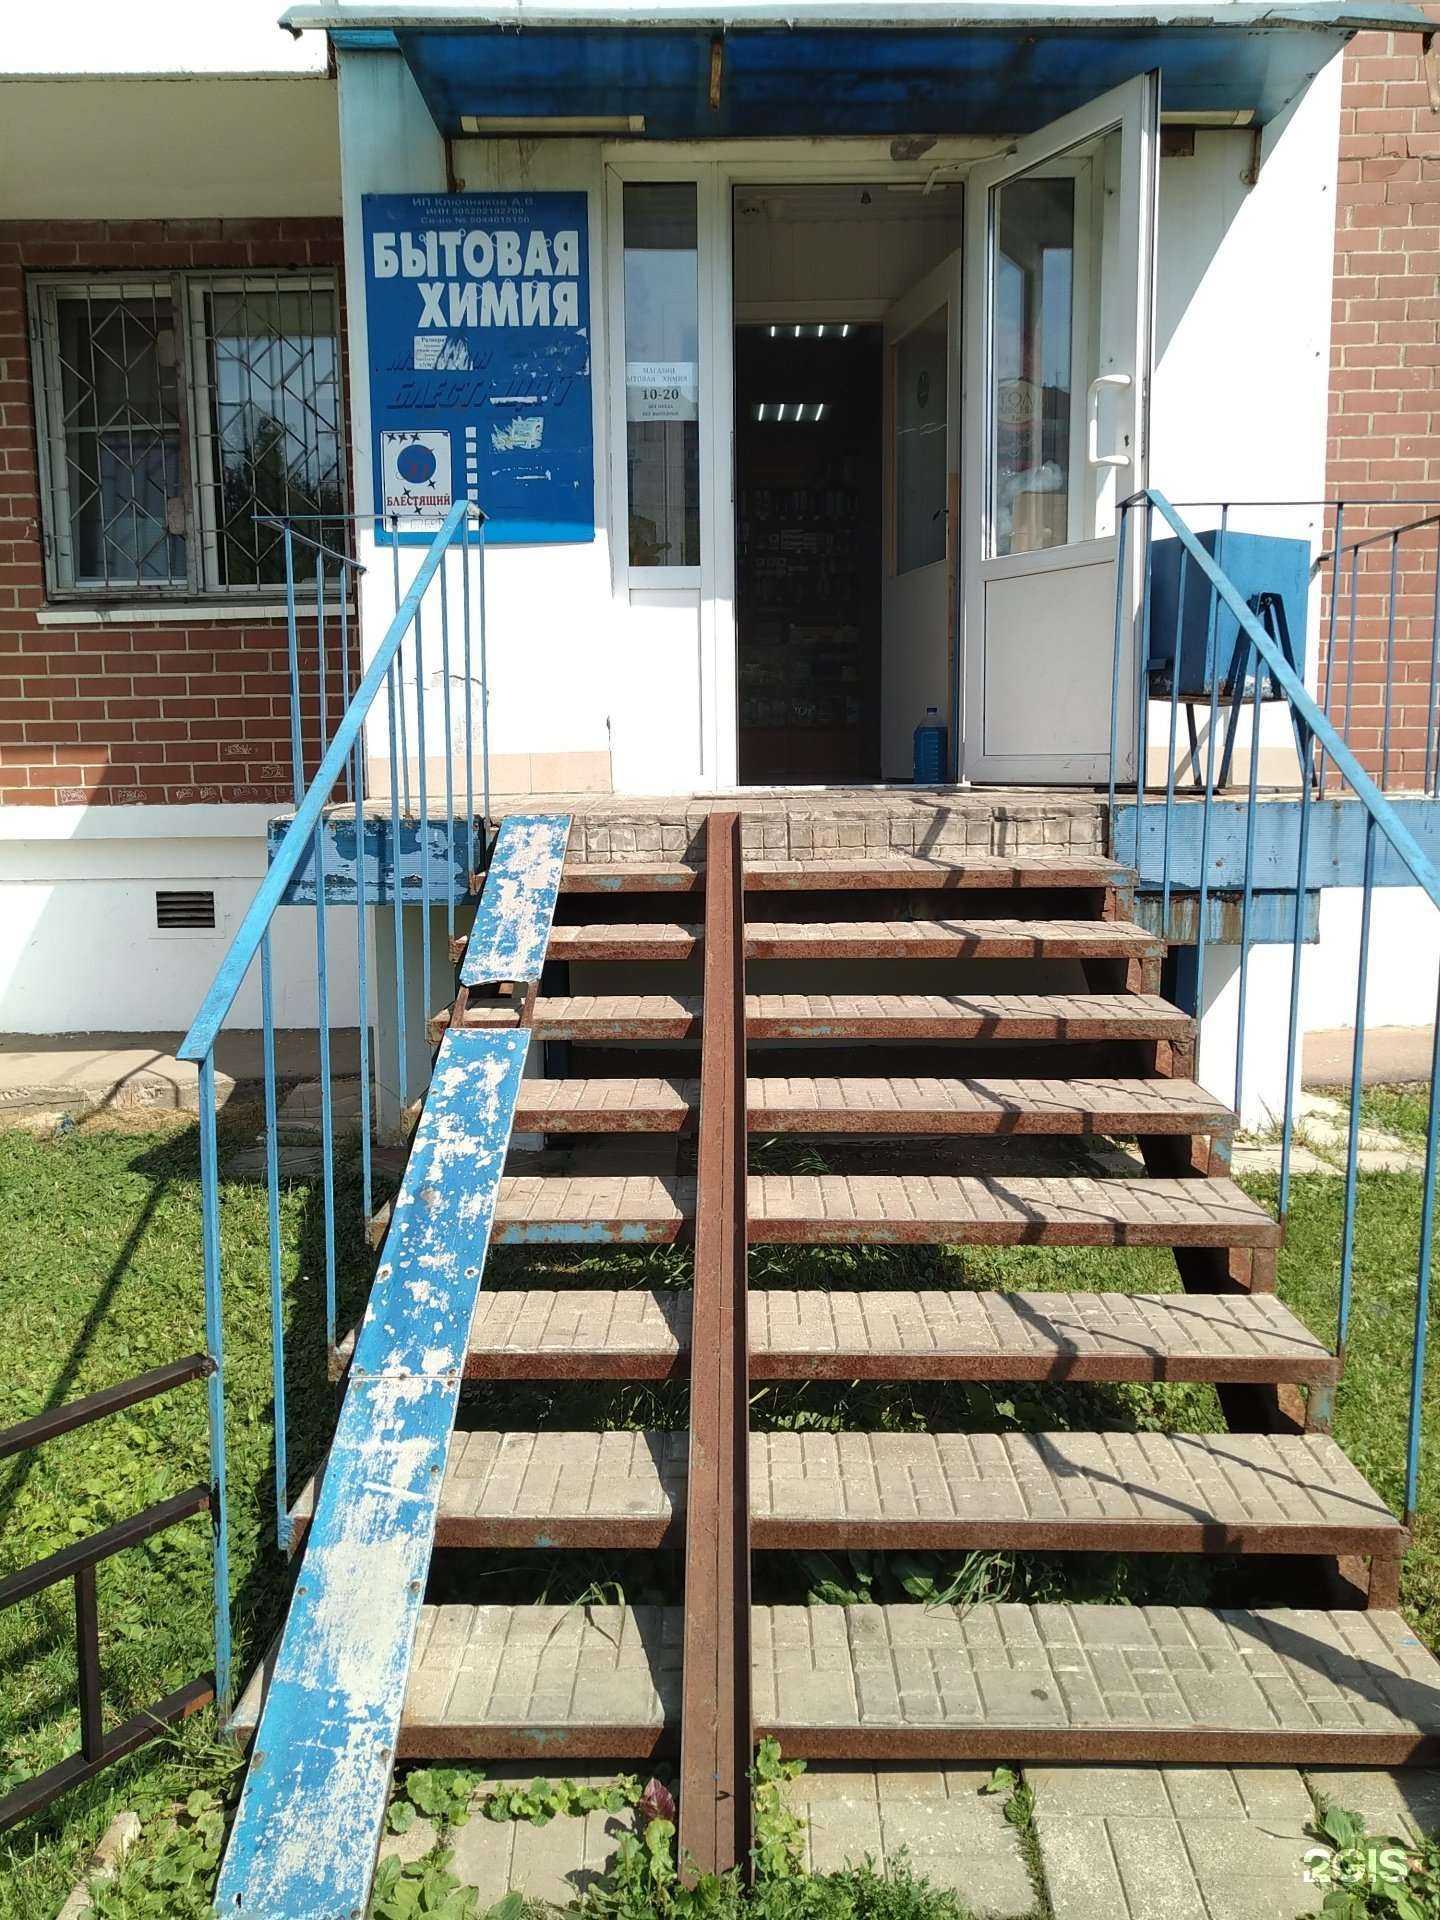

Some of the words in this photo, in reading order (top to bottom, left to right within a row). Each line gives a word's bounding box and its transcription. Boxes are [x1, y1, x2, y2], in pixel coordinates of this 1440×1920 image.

[373, 229, 580, 278] БЫТОВАЯ
[417, 280, 579, 328] ХИМИЯ
[642, 388, 680, 400] 10-20
[386, 493, 451, 507] БЛЕСТЯЩИЙ
